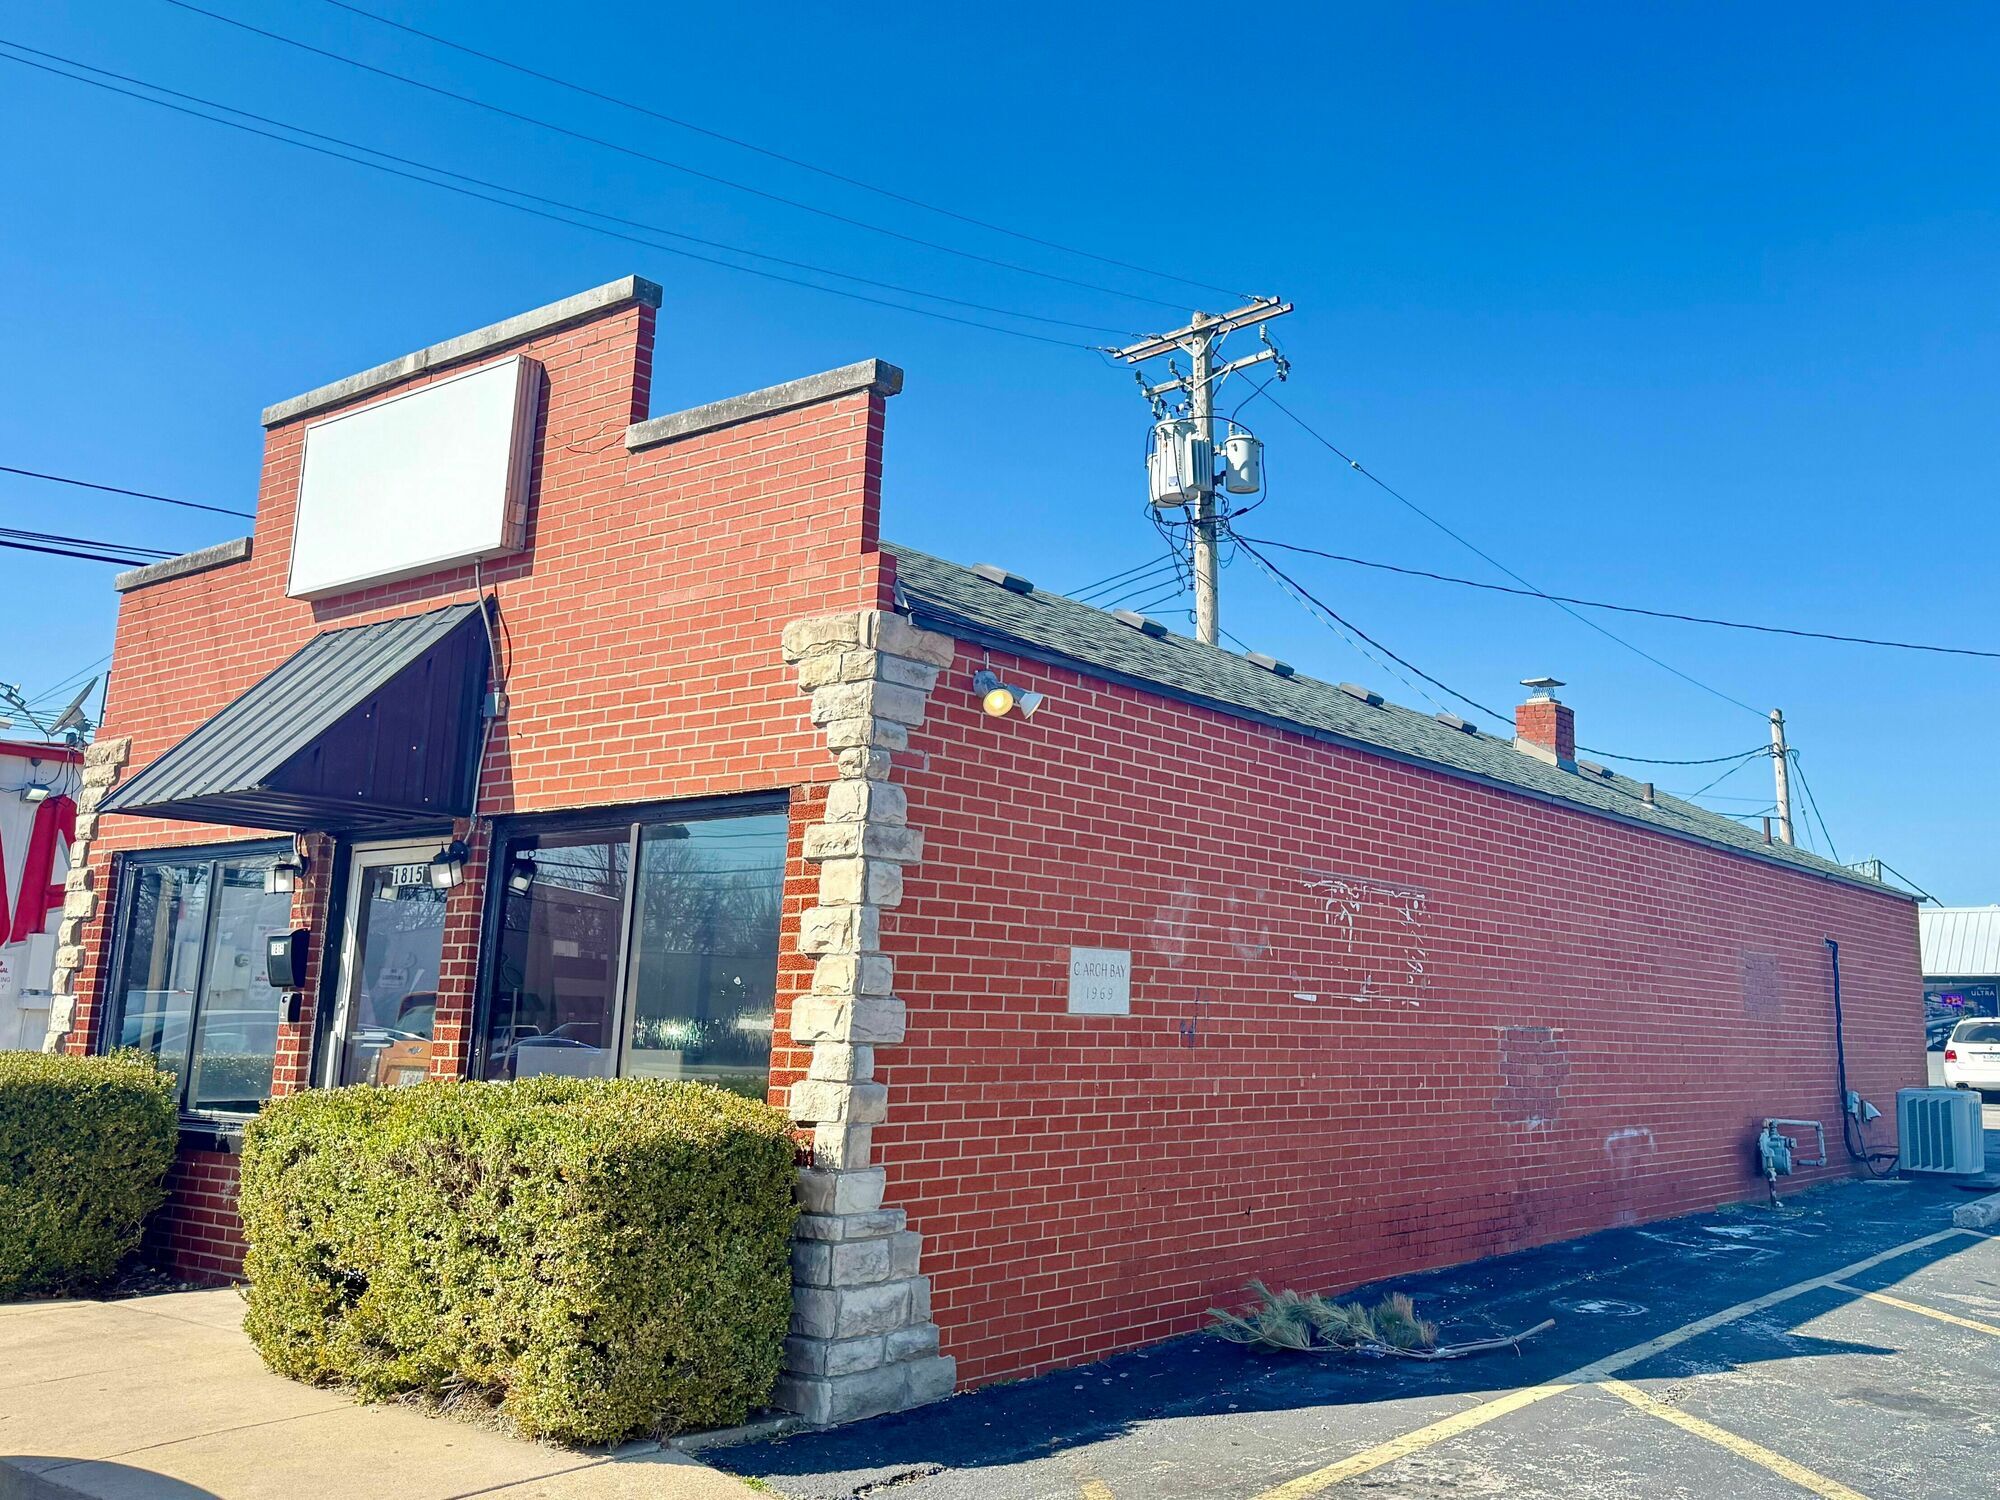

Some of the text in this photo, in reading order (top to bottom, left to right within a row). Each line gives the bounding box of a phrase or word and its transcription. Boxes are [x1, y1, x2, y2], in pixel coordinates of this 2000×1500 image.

[394, 865, 423, 884] 1815
[1083, 962, 1108, 977] ARCH
[1110, 963, 1126, 978] BAY
[1086, 986, 1113, 1000] 1969
